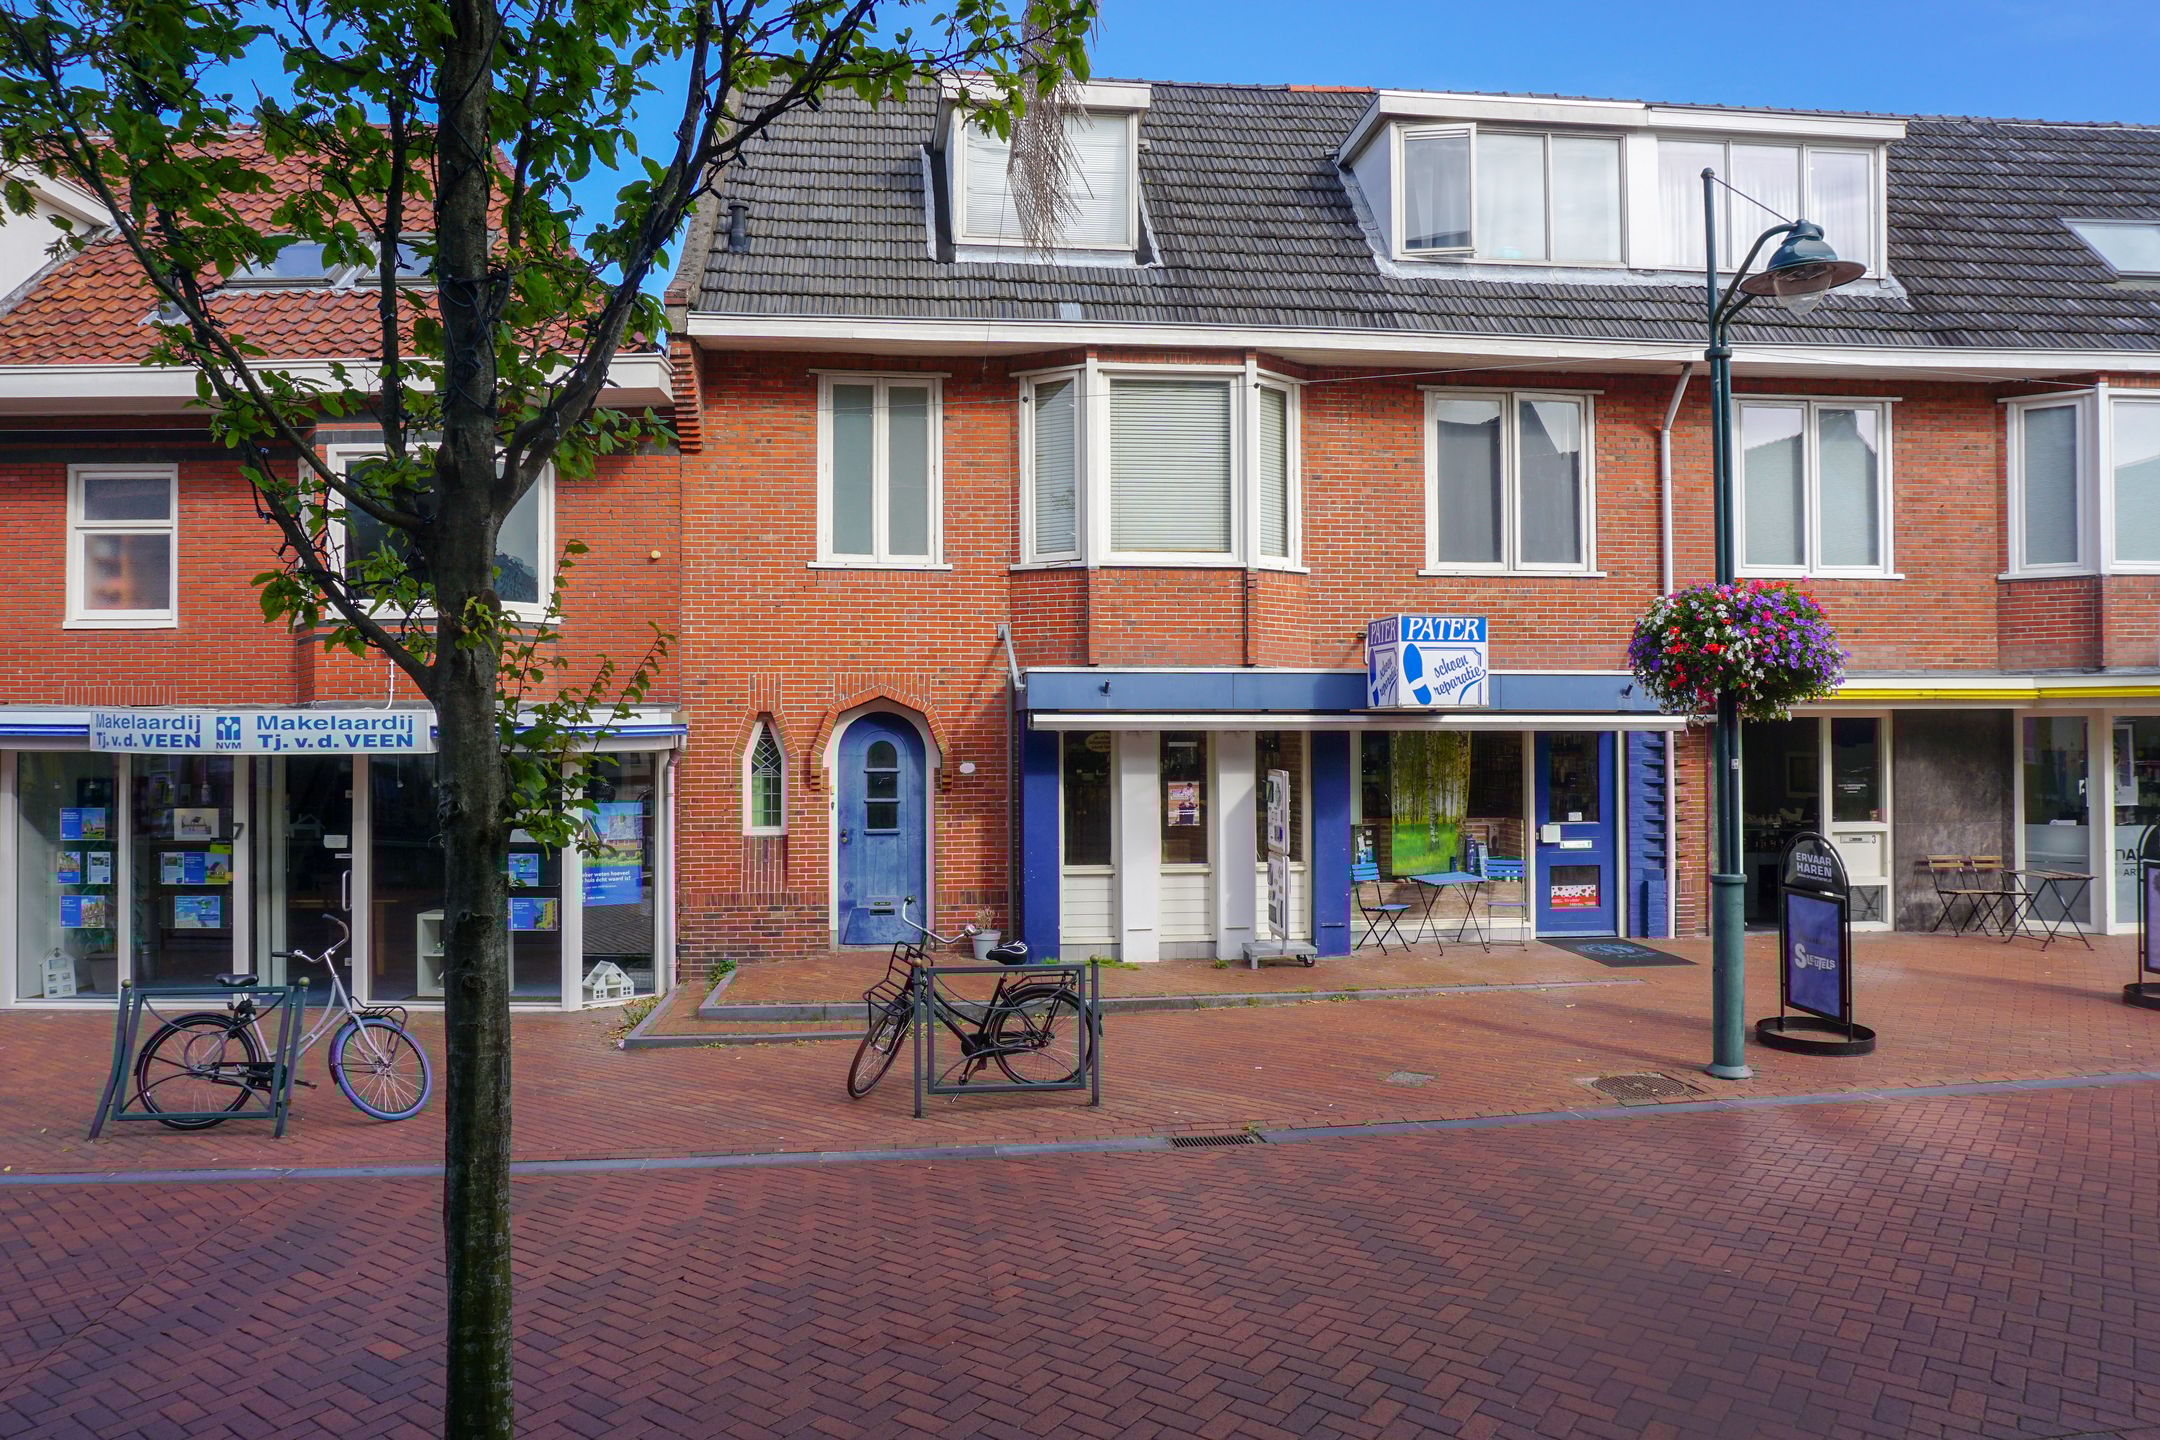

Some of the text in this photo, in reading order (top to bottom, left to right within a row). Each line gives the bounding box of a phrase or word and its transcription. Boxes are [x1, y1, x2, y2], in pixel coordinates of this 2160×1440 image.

[1370, 619, 1397, 645] PATER
[1406, 617, 1480, 640] PATER
[1434, 655, 1469, 678] schoen
[1433, 665, 1482, 696] reparatie
[95, 713, 201, 734] Makelaardij
[256, 715, 413, 734] Makelaardij
[141, 734, 201, 748] VEEN
[344, 734, 413, 748] VEEN
[232, 822, 245, 840] 7
[1871, 834, 1877, 844] 3
[1796, 851, 1832, 866] ERVAAR
[1796, 862, 1832, 878] HAREN
